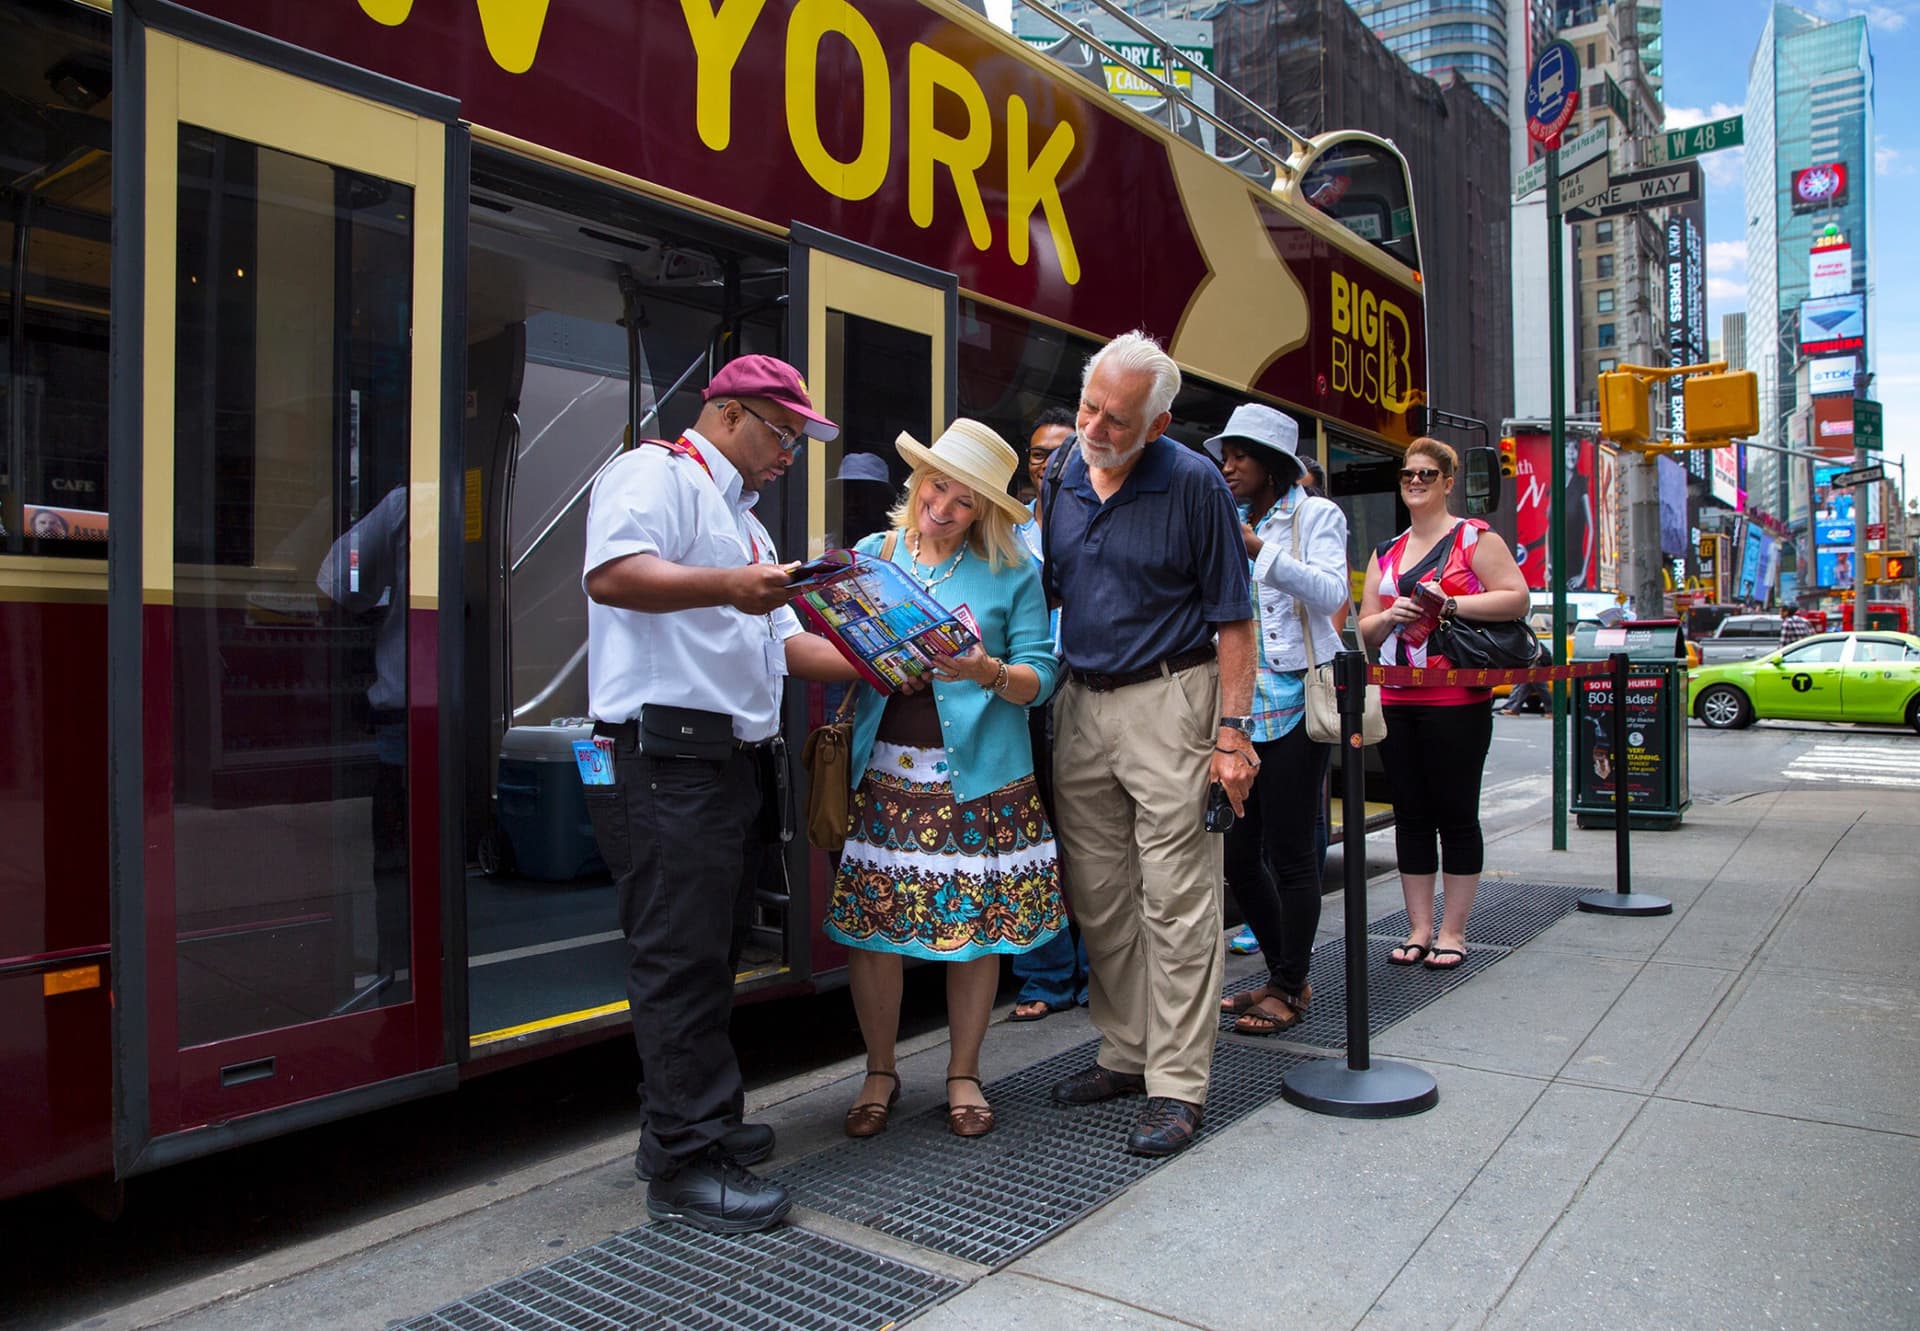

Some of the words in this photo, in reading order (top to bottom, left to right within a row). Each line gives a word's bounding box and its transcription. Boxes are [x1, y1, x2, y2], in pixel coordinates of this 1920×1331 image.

[680, 0, 1080, 285] YORK
[1672, 132, 1686, 157] W
[1694, 125, 1716, 150] 48
[1723, 119, 1737, 134] ST
[1640, 175, 1681, 198] WAY
[1331, 271, 1378, 348] BIG
[1669, 262, 1683, 322] EXPRESS
[1801, 337, 1864, 354] TOSHIBA
[1332, 336, 1378, 404] BUS
[1823, 368, 1851, 381] TDK
[1588, 692, 1607, 704] 50
